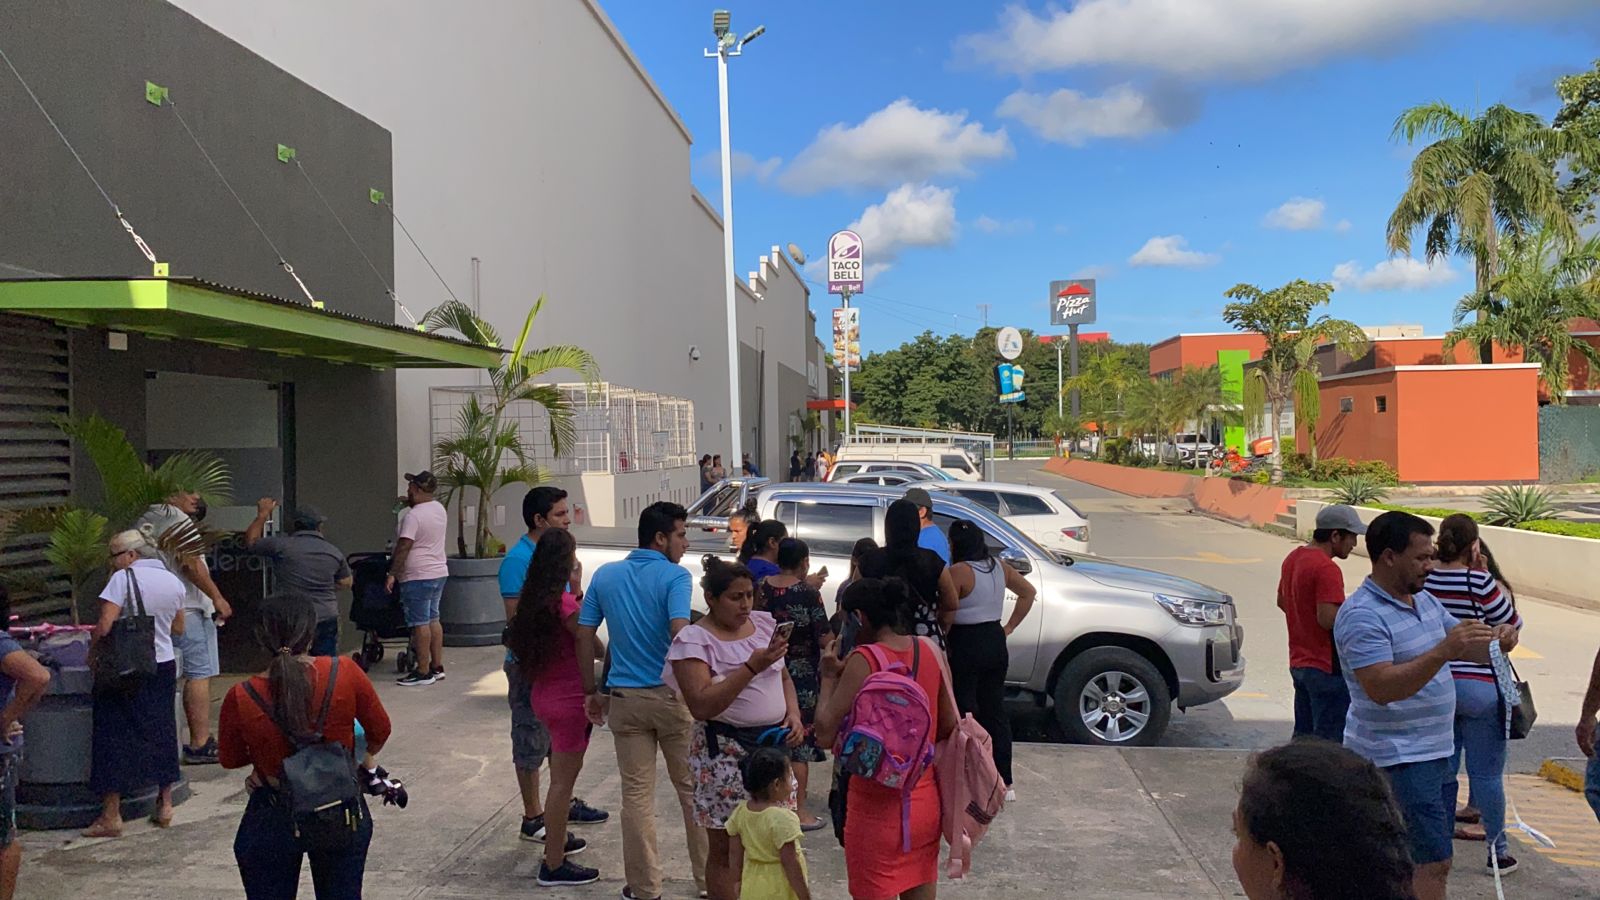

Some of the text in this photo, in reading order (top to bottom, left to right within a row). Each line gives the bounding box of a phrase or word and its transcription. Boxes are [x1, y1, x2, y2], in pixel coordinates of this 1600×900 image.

[832, 261, 860, 270] TACO
[833, 271, 860, 280] BELL
[1056, 295, 1091, 312] Pizza
[1062, 304, 1089, 319] Hut
